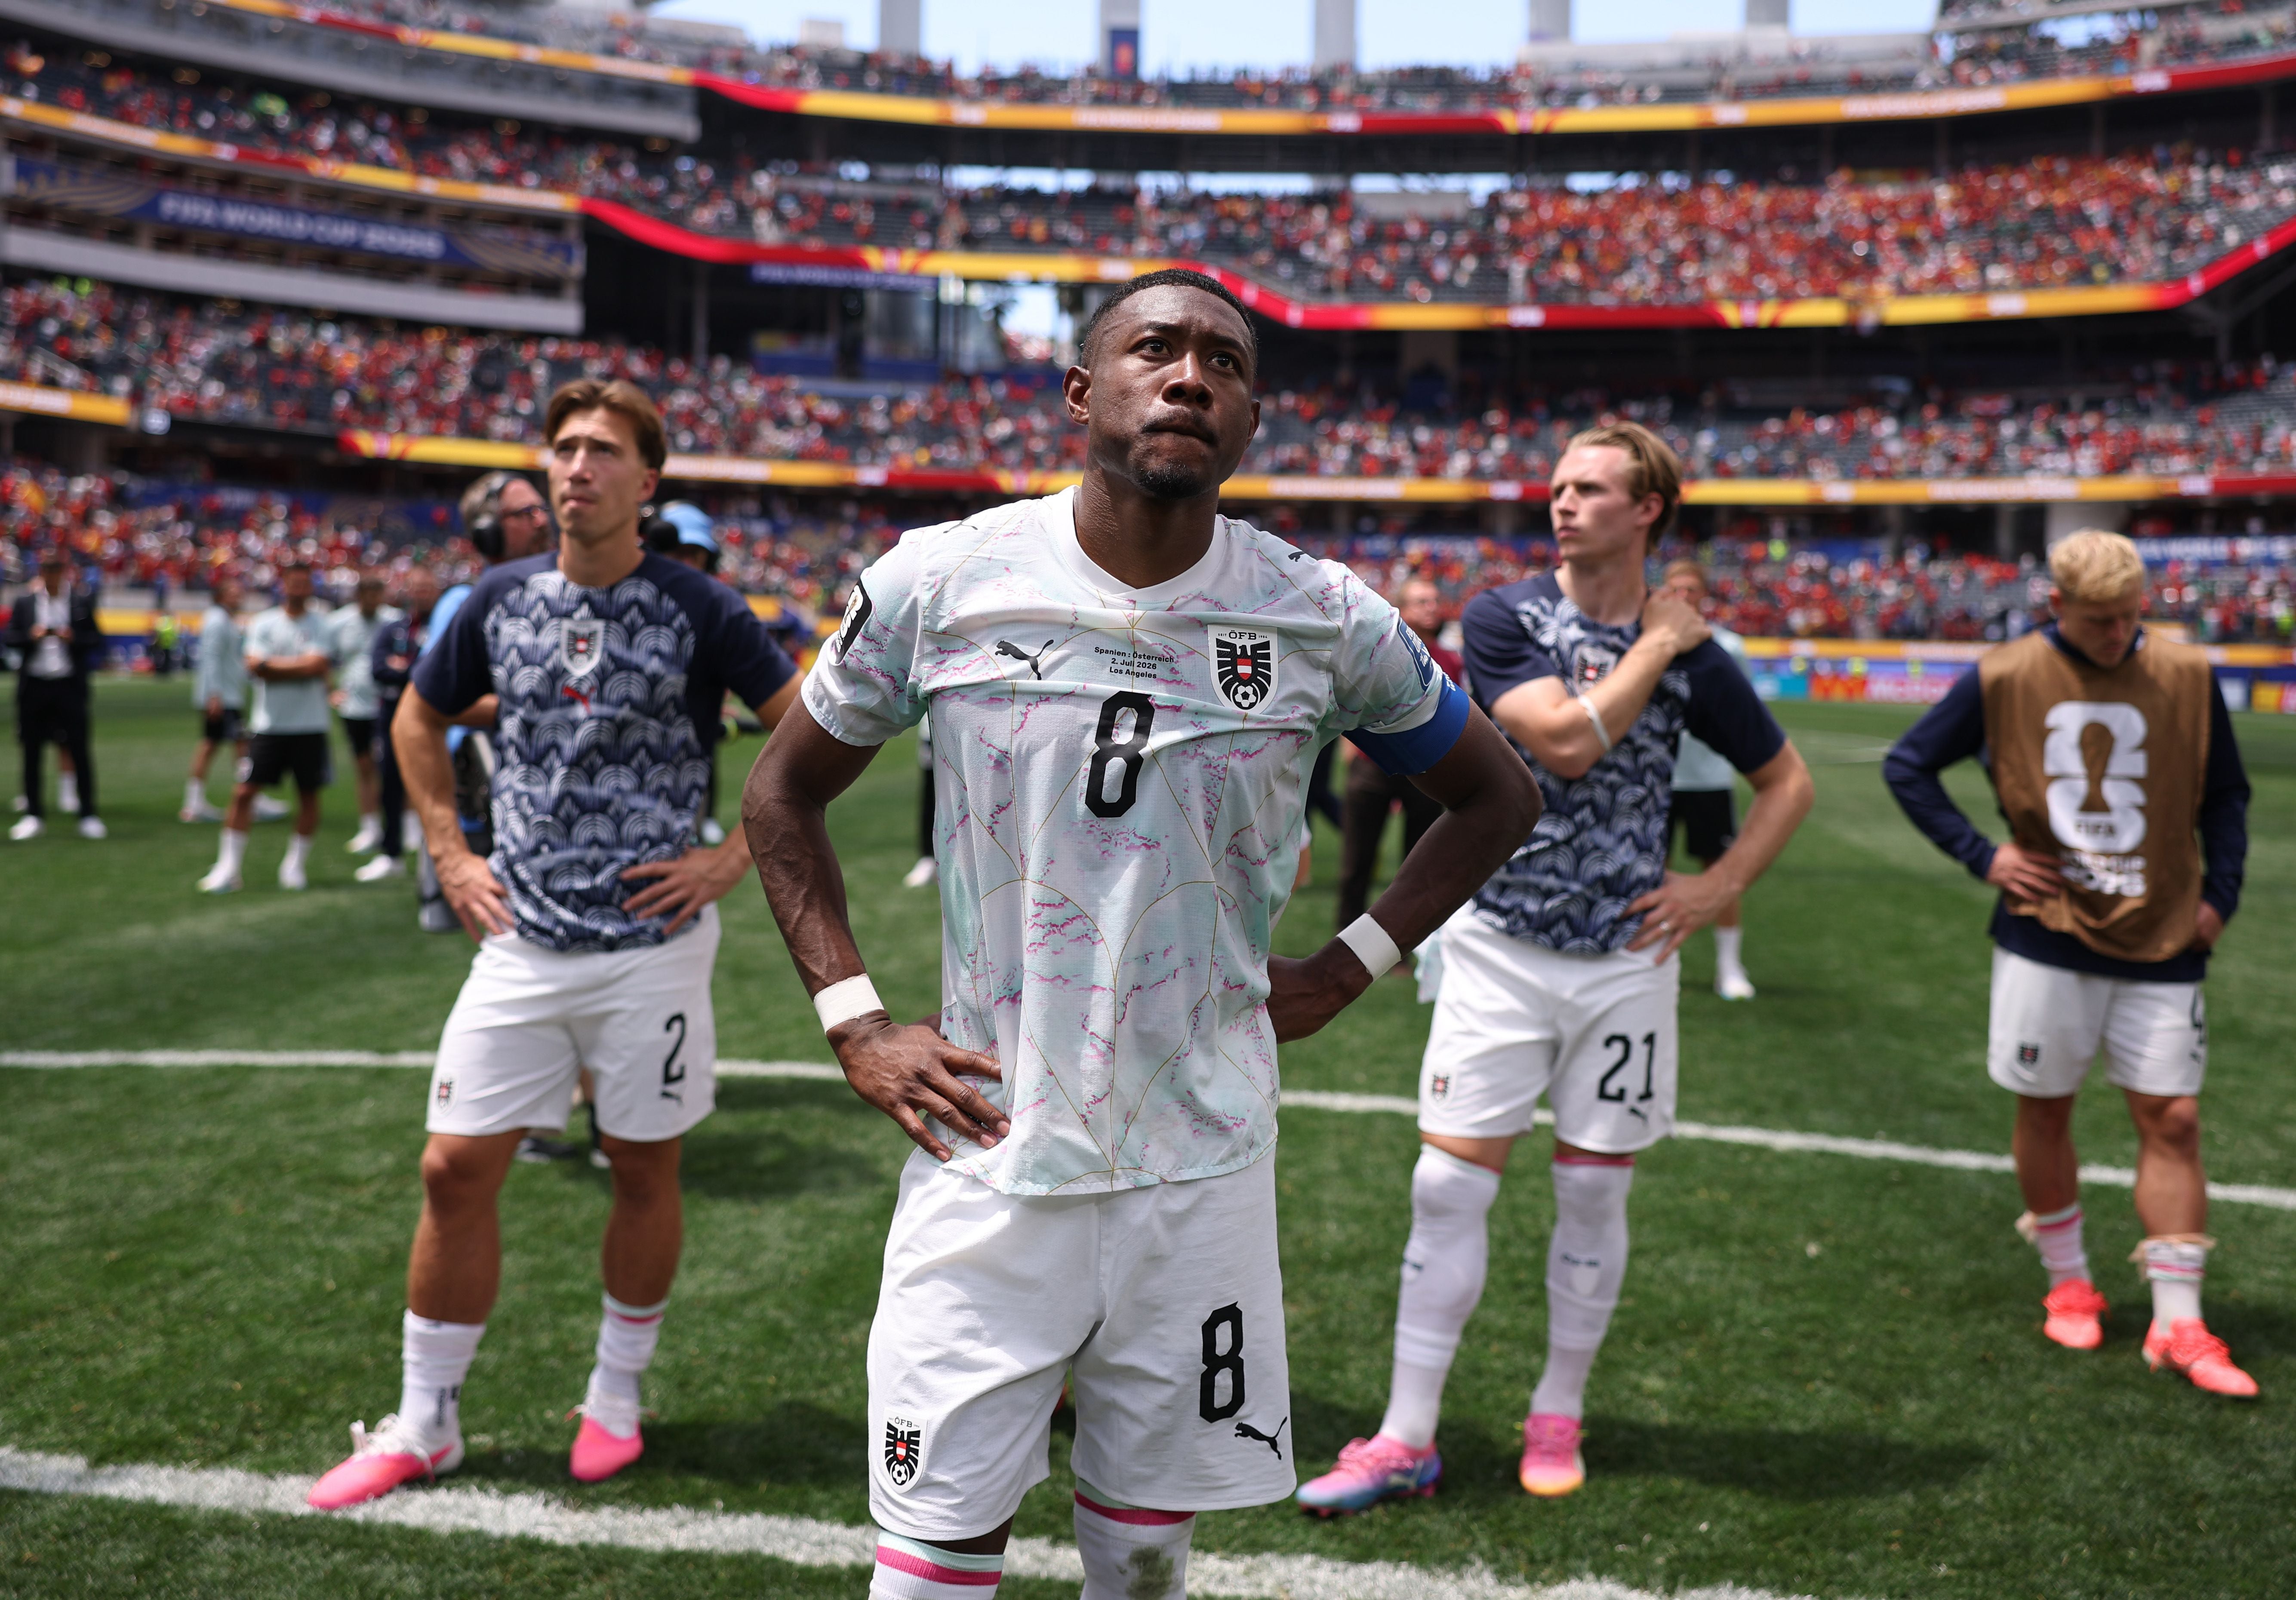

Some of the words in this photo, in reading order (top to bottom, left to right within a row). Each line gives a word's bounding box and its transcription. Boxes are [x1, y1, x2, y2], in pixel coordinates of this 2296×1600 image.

[1229, 630, 1256, 640] ÖFB
[1094, 646, 1126, 657] Spanien
[1133, 651, 1174, 663] Österreich
[1136, 662, 1157, 670] 2026
[1125, 669, 1157, 679] Angeles
[1085, 690, 1155, 818] 8
[2076, 823, 2116, 836] FIFA
[663, 1013, 686, 1086] 2
[1598, 1031, 1655, 1102] 21
[1200, 1301, 1245, 1424] 8
[895, 1416, 912, 1428] ÖFB
